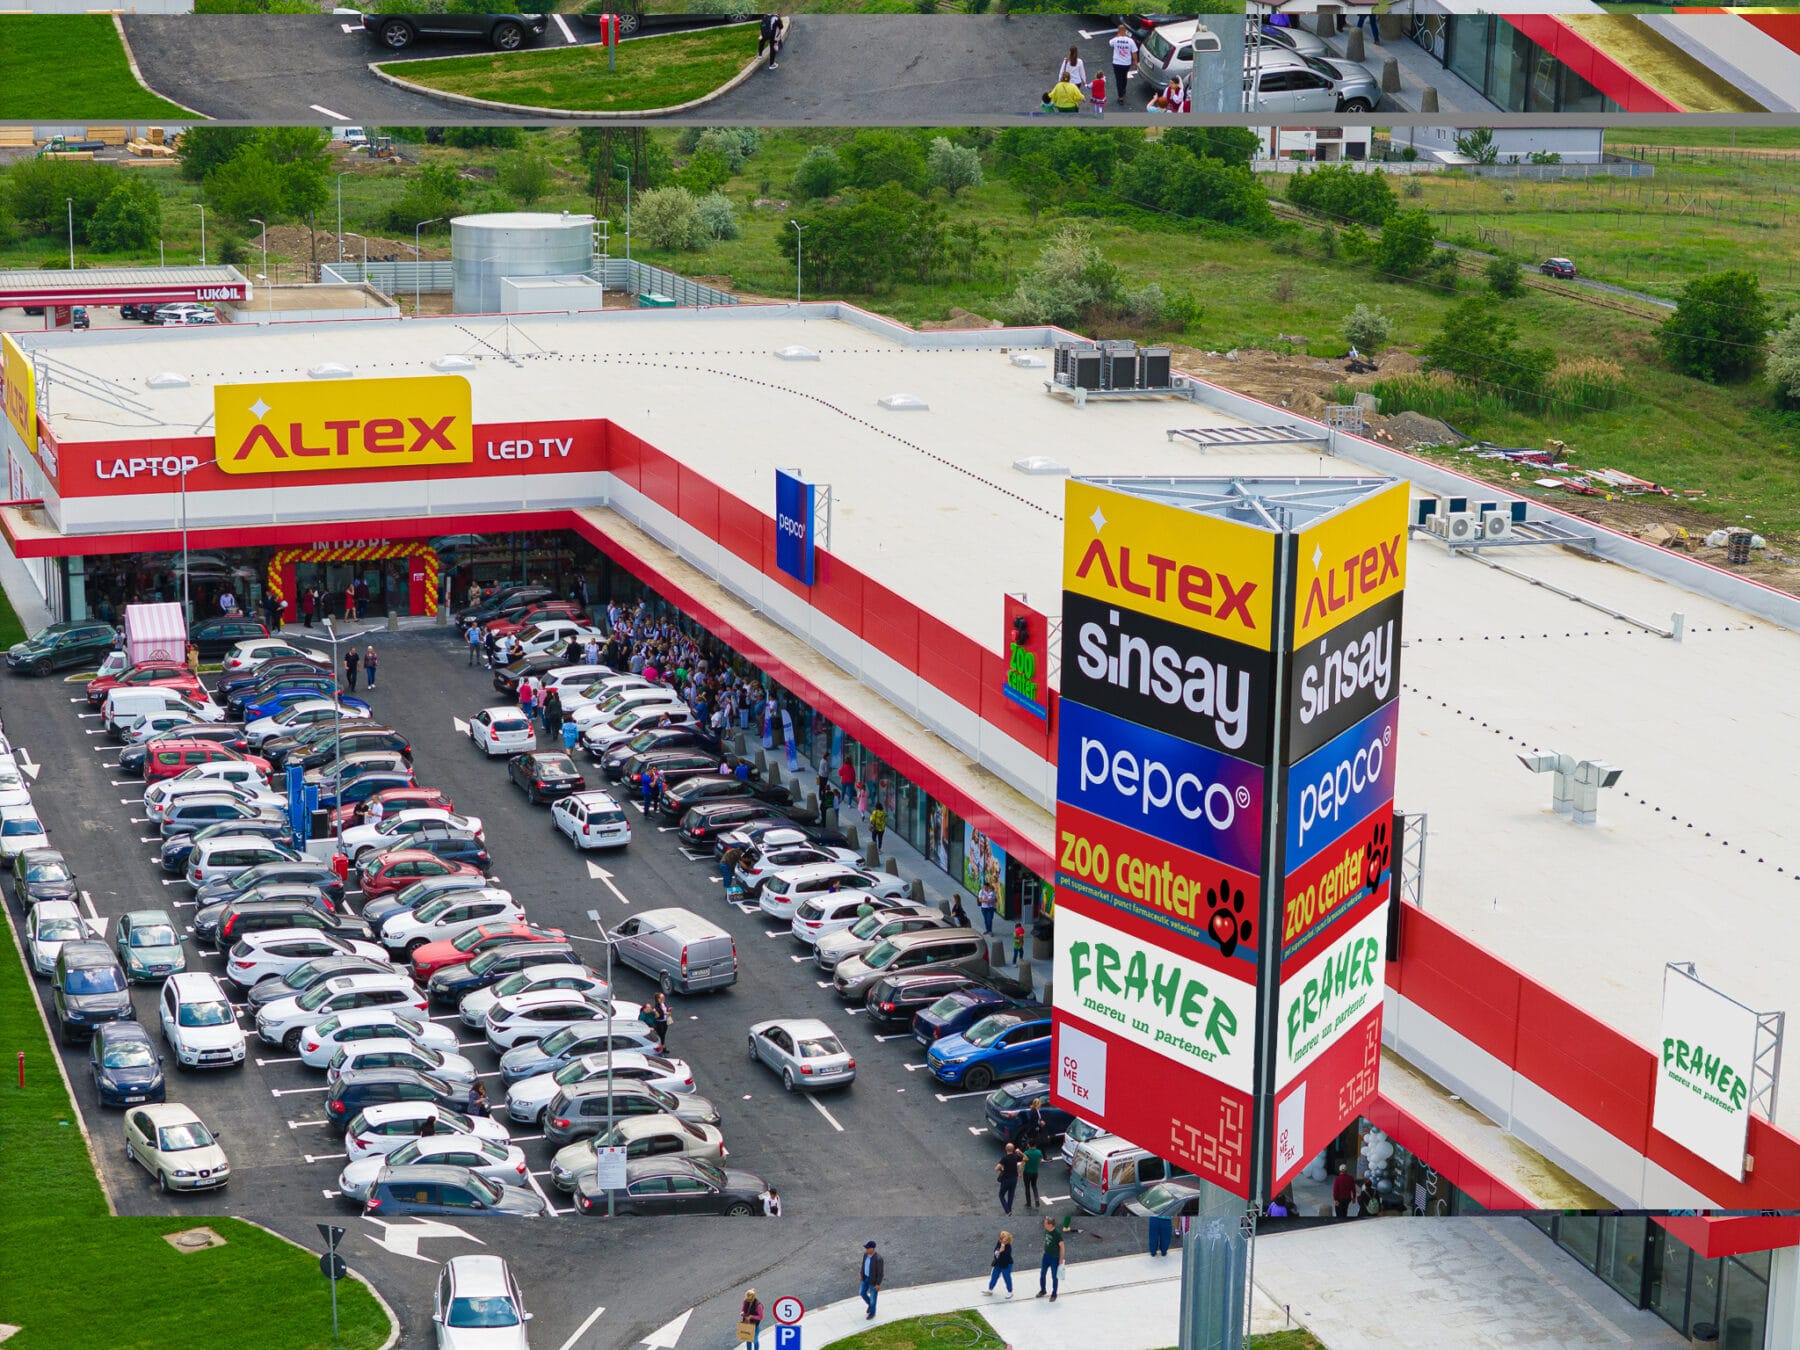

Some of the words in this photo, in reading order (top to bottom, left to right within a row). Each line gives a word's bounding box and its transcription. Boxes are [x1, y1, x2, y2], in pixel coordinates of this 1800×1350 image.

[196, 286, 241, 300] LUKOIL
[96, 455, 199, 479] LAPTOP
[487, 440, 533, 460] LED
[539, 438, 574, 458] TV
[779, 513, 803, 539] pepco
[1078, 610, 1250, 749] sinsay
[1300, 619, 1394, 724] sinsay
[1081, 736, 1235, 831] pepco
[1299, 738, 1383, 848] pepco
[1061, 830, 1110, 884] zoo
[1116, 853, 1201, 920] center
[1318, 845, 1365, 914] center
[1071, 879, 1110, 903] supermarket
[1113, 896, 1132, 910] punct
[1132, 902, 1169, 925] farmaceutic
[1170, 919, 1200, 938] veterinar
[1069, 940, 1238, 1056] FRAHER
[1287, 937, 1379, 1061] FRAHER
[1083, 996, 1126, 1024] mereu
[1131, 1017, 1149, 1034] un
[1154, 1026, 1218, 1063] partener
[1063, 1056, 1078, 1070] CO
[1063, 1067, 1078, 1082] ME
[1072, 1083, 1089, 1100] TEX
[1663, 1037, 1747, 1111] FRAHER
[1668, 1070, 1691, 1088] mereu
[1692, 1084, 1702, 1095] un
[1703, 1091, 1736, 1114] partener
[781, 1328, 796, 1346] P
[784, 1304, 792, 1318] 5
